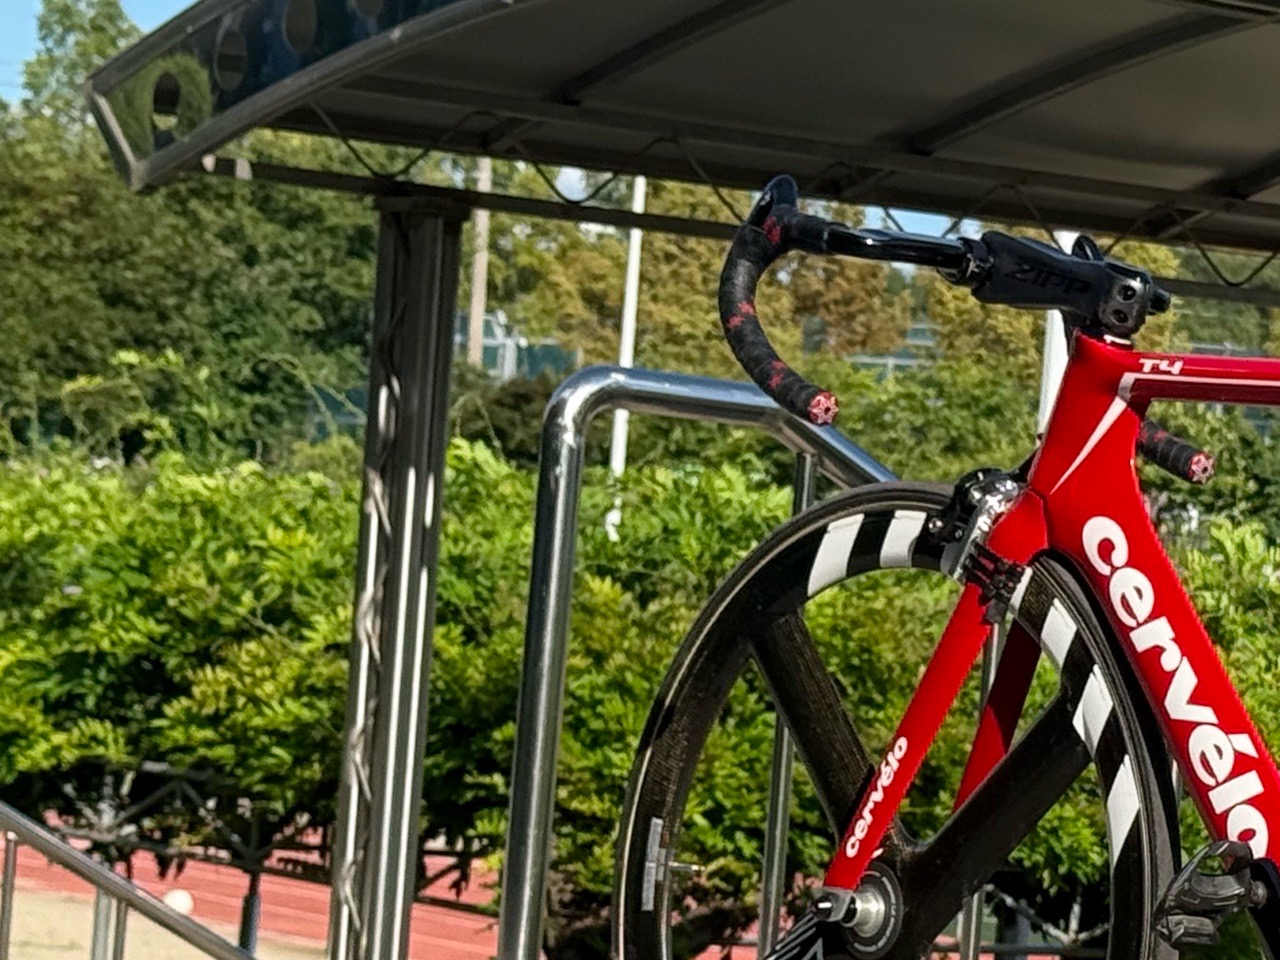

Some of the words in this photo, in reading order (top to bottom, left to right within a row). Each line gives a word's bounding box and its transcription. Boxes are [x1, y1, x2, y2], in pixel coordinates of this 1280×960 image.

[1138, 357, 1184, 376] T4
[1082, 515, 1269, 860] cervélo
[845, 736, 908, 858] cervélo
